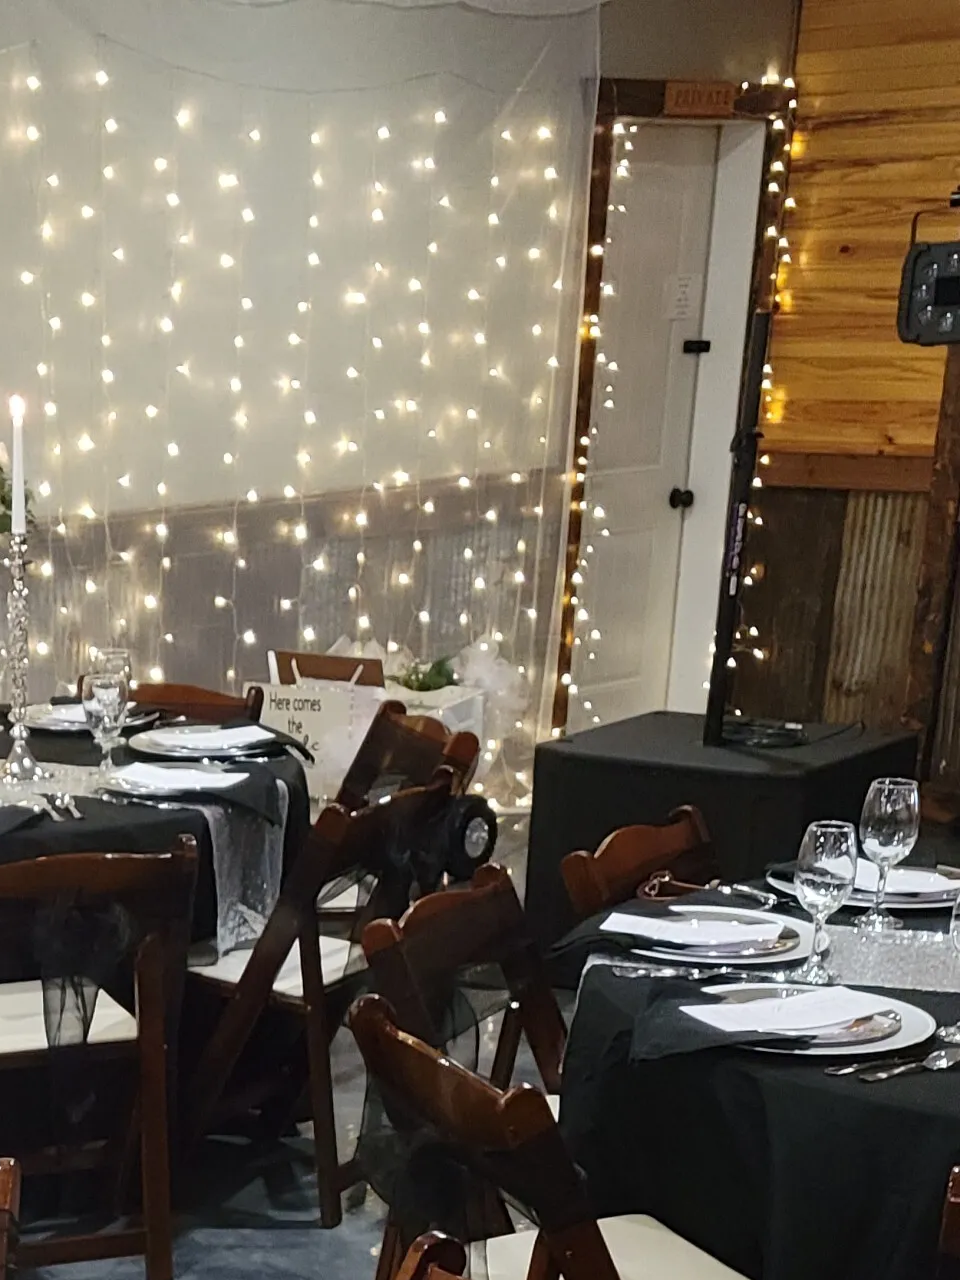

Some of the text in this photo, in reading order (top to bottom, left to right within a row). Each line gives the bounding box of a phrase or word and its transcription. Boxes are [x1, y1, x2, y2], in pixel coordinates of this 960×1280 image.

[674, 88, 730, 106] PRIVATE
[269, 691, 321, 712] Here comes
[287, 714, 302, 734] the
